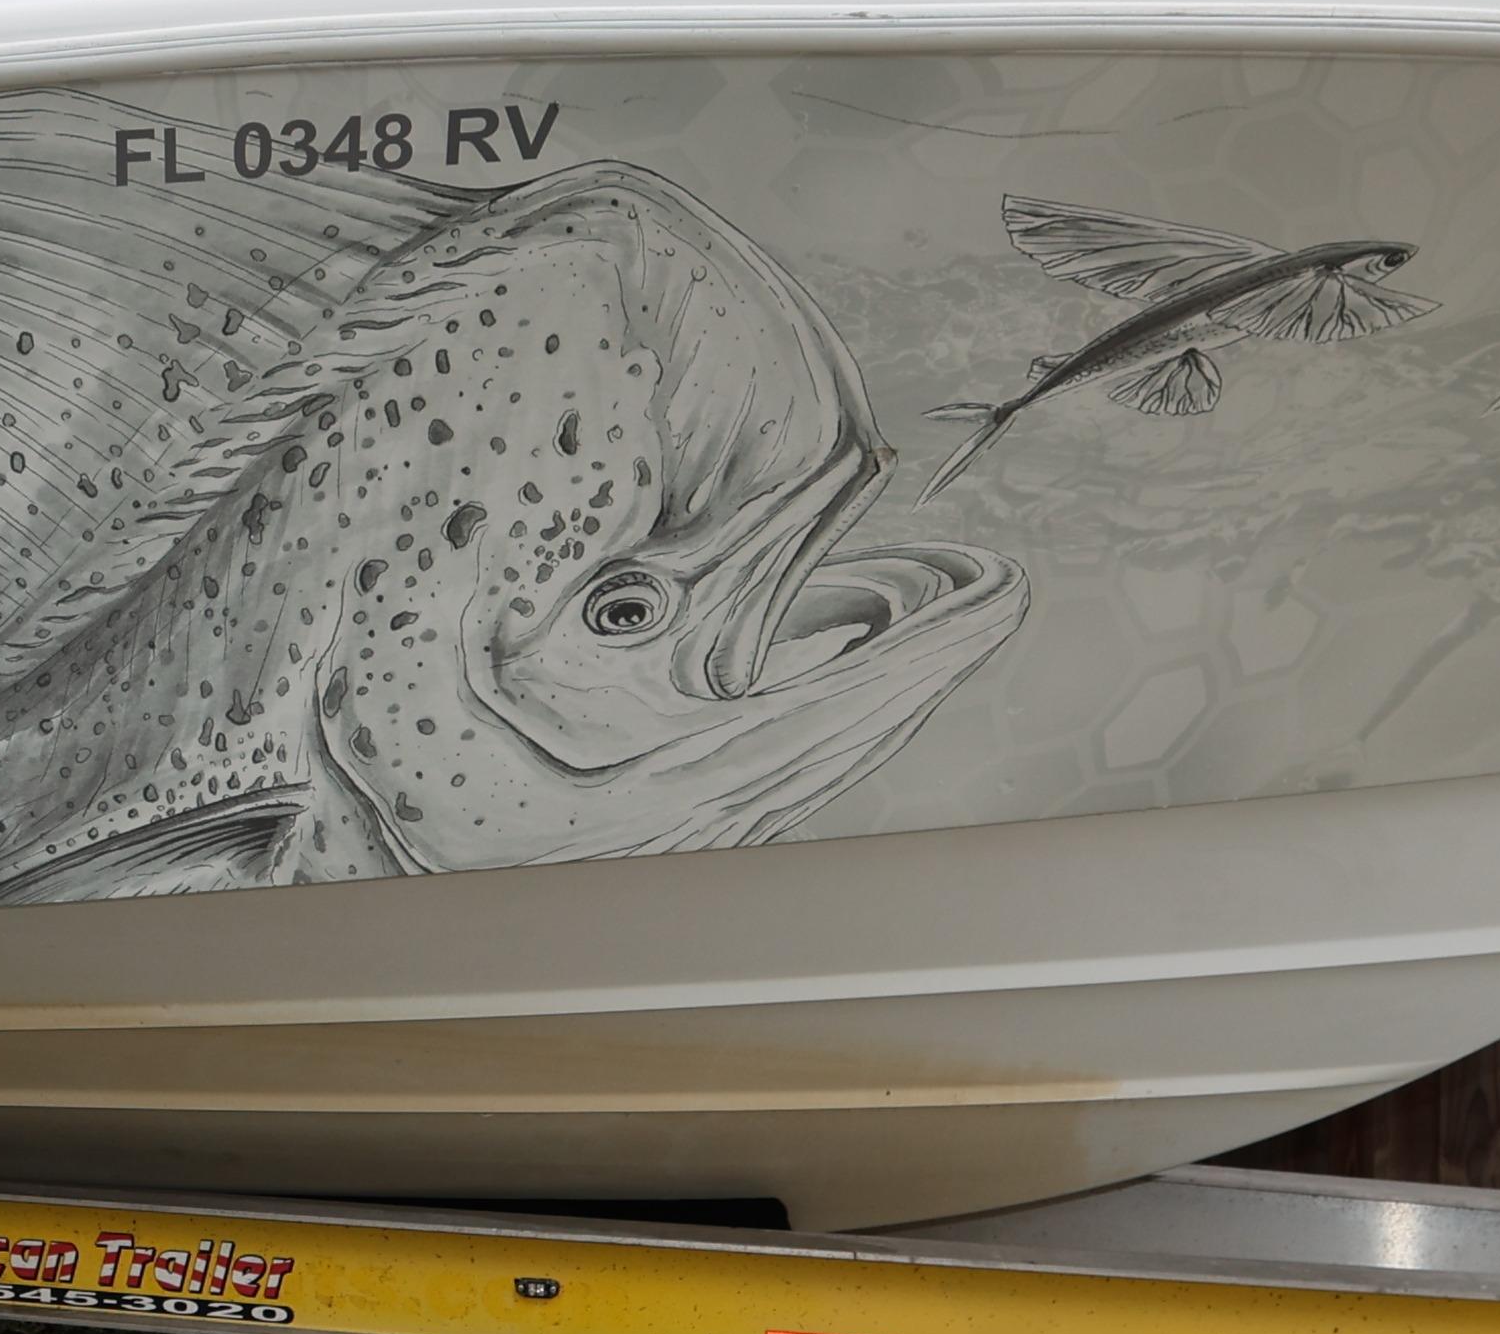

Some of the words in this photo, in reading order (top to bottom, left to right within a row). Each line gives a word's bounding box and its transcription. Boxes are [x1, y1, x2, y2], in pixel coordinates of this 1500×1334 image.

[114, 126, 206, 188] FL
[233, 112, 414, 180] 0348
[444, 101, 560, 166] RV
[94, 1230, 296, 1299] Trailer
